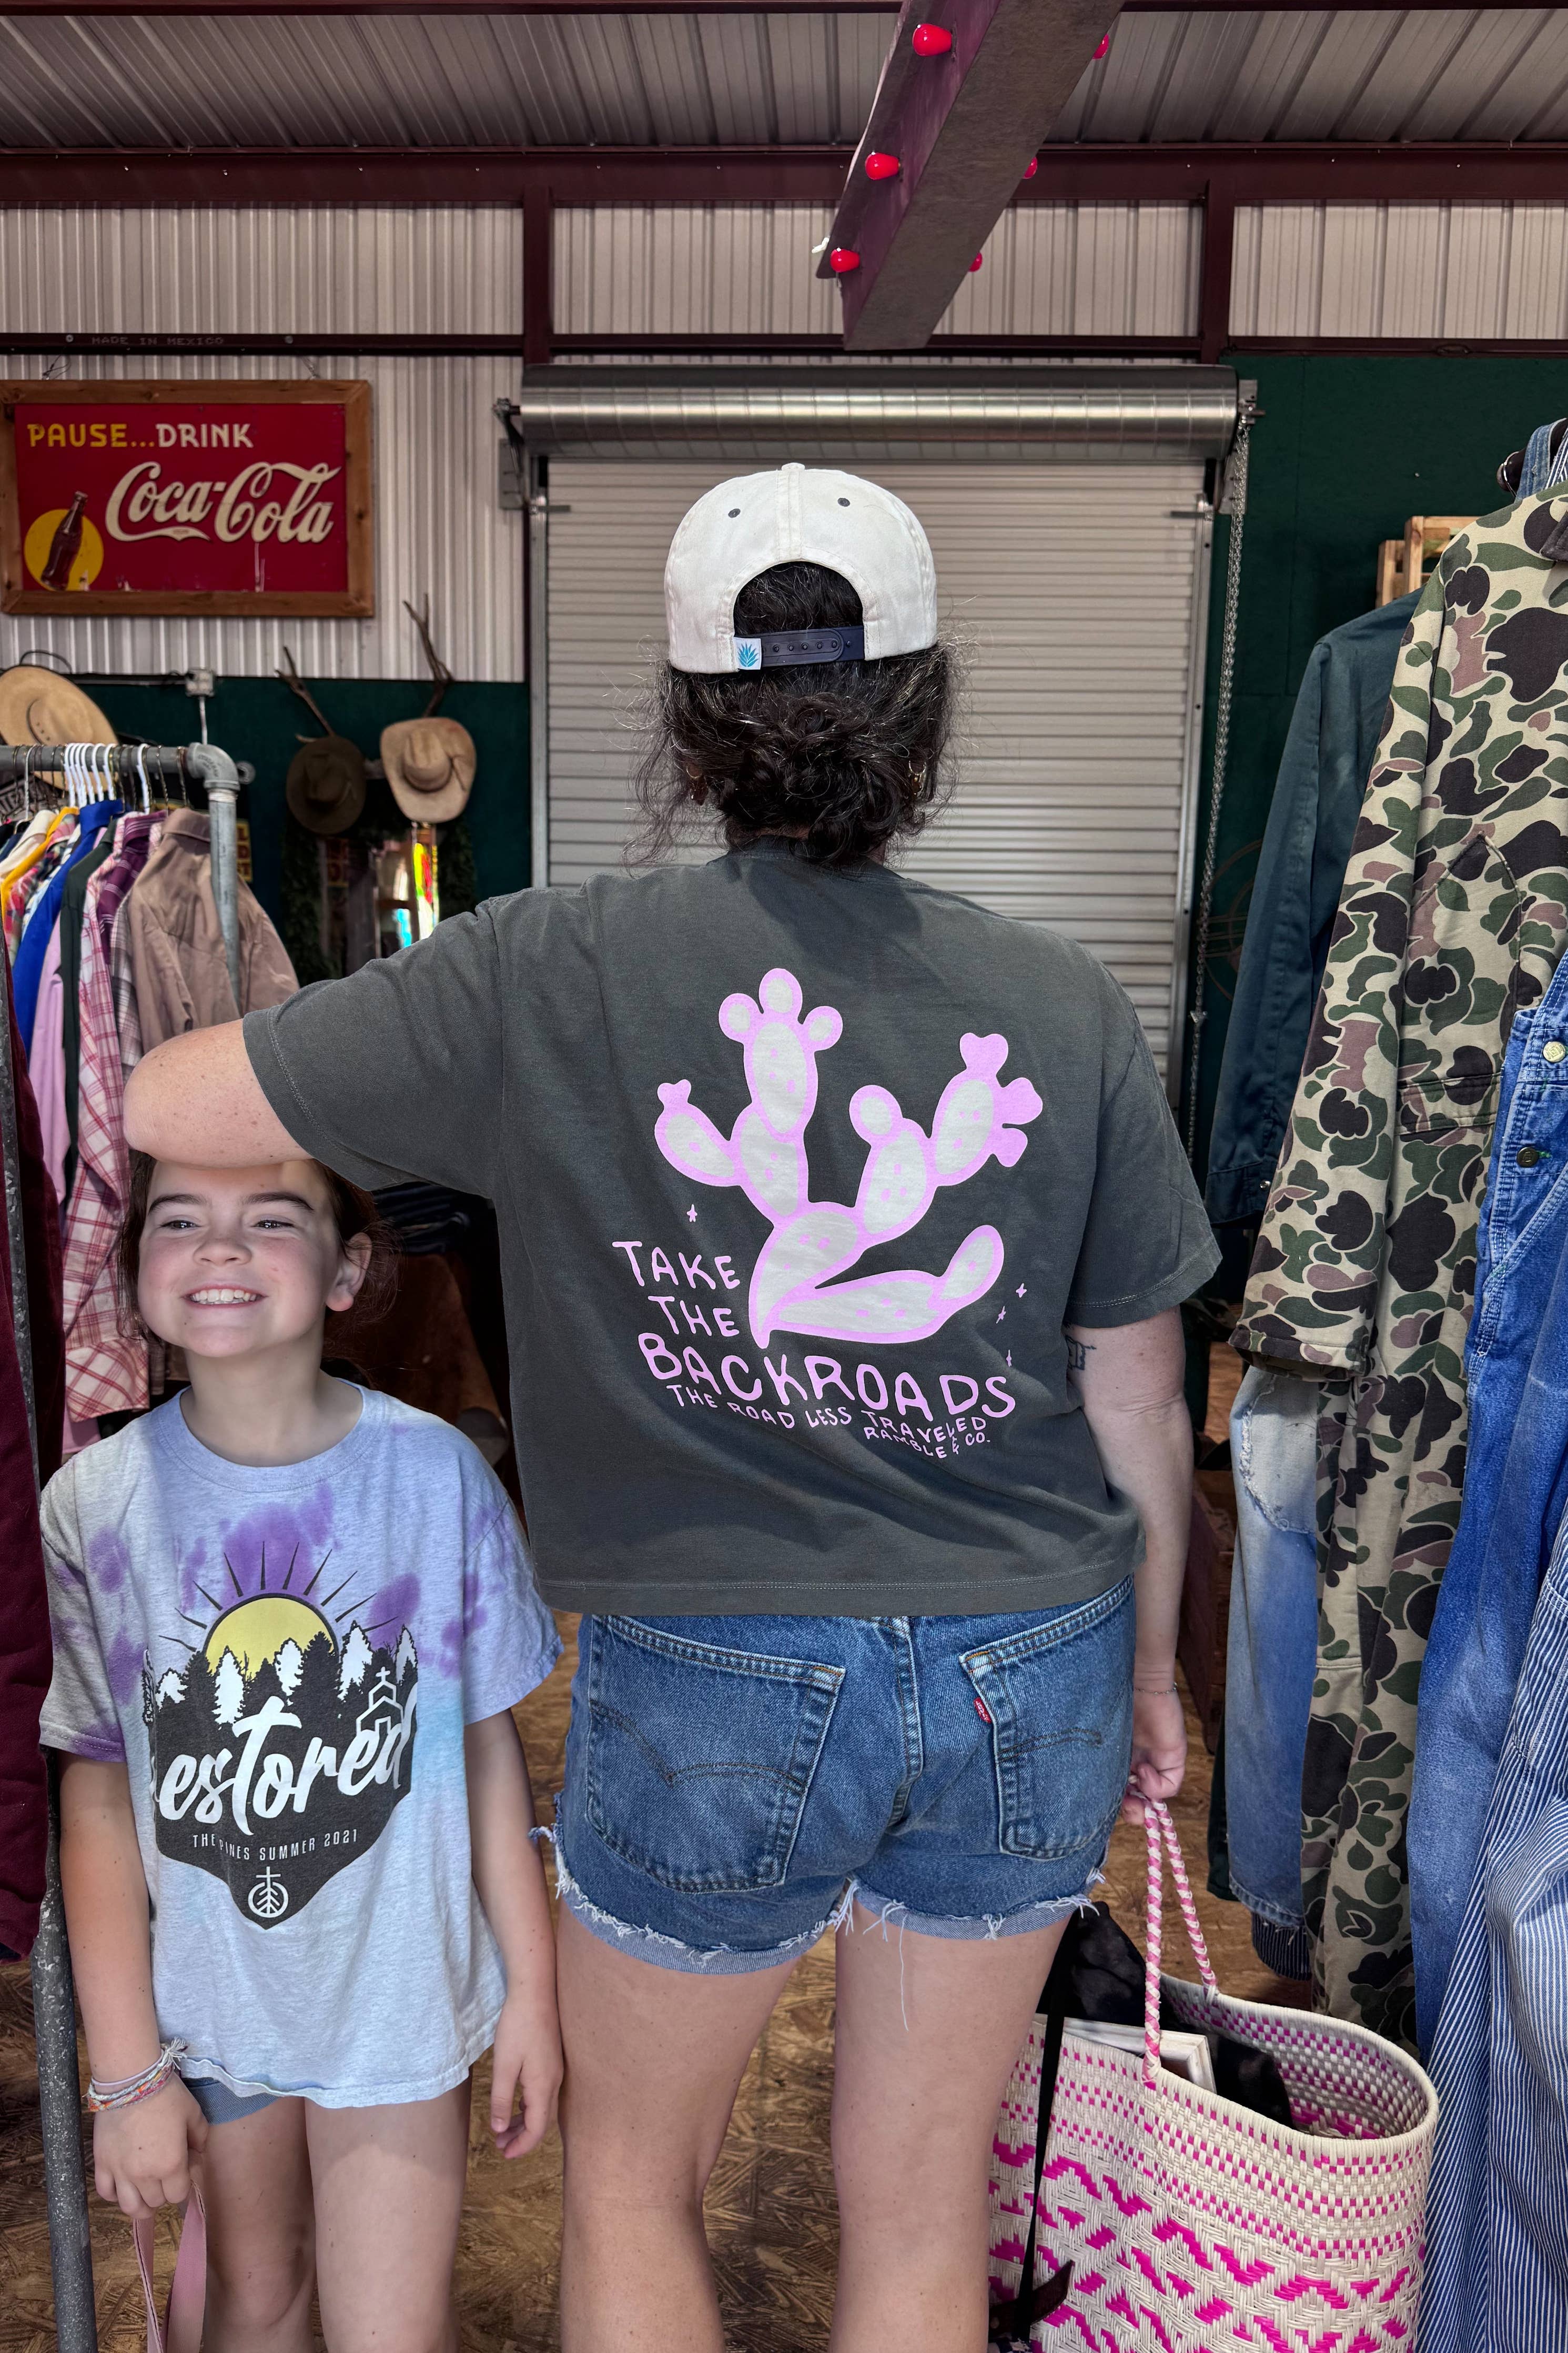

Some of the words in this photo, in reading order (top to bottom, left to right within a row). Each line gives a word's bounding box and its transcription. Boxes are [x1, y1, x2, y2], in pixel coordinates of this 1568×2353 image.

[91, 336, 129, 345] MADE
[139, 337, 158, 345] IN
[166, 337, 224, 346] MEXICO
[105, 461, 341, 543] Coca-Cola
[612, 1240, 741, 1290] TAKE
[648, 1295, 740, 1338] THE
[638, 1332, 1016, 1422] BACKROADS
[665, 1384, 719, 1409] THE
[726, 1402, 795, 1429] ROAD
[804, 1406, 853, 1429] LESS
[860, 1410, 987, 1443] TRAVELED
[863, 1426, 948, 1459] RAMBLE
[952, 1435, 960, 1455] &
[965, 1431, 991, 1446] CO.
[193, 1833, 216, 1848] THE
[219, 1839, 250, 1860] PINES
[259, 1837, 316, 1861] SUMMER
[323, 1828, 357, 1847] 2021
